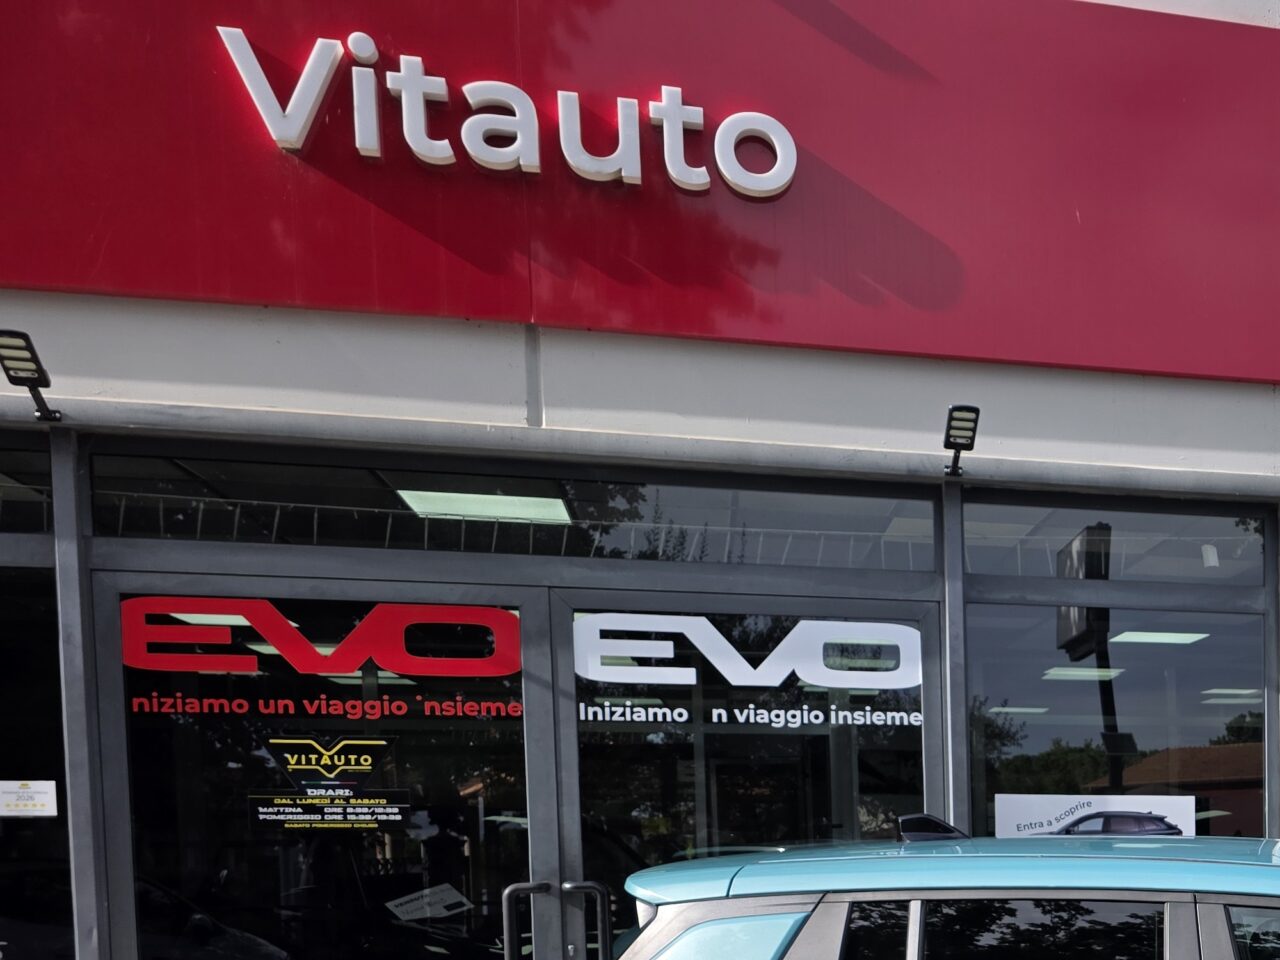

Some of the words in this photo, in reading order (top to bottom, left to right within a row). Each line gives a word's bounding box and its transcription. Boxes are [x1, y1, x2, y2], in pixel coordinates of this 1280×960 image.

[216, 26, 798, 198] Vitauto
[120, 596, 522, 677] EVO
[572, 612, 922, 690] EVO
[258, 699, 295, 715] un
[303, 693, 408, 720] viaggio
[415, 694, 523, 717] nsieme
[579, 701, 689, 723] Iniziamo
[734, 704, 824, 728] viaggio
[830, 705, 923, 727] insieme
[284, 753, 373, 766] VITAUTO
[1016, 821, 1045, 833] Entra
[1054, 800, 1094, 824] scoprire
